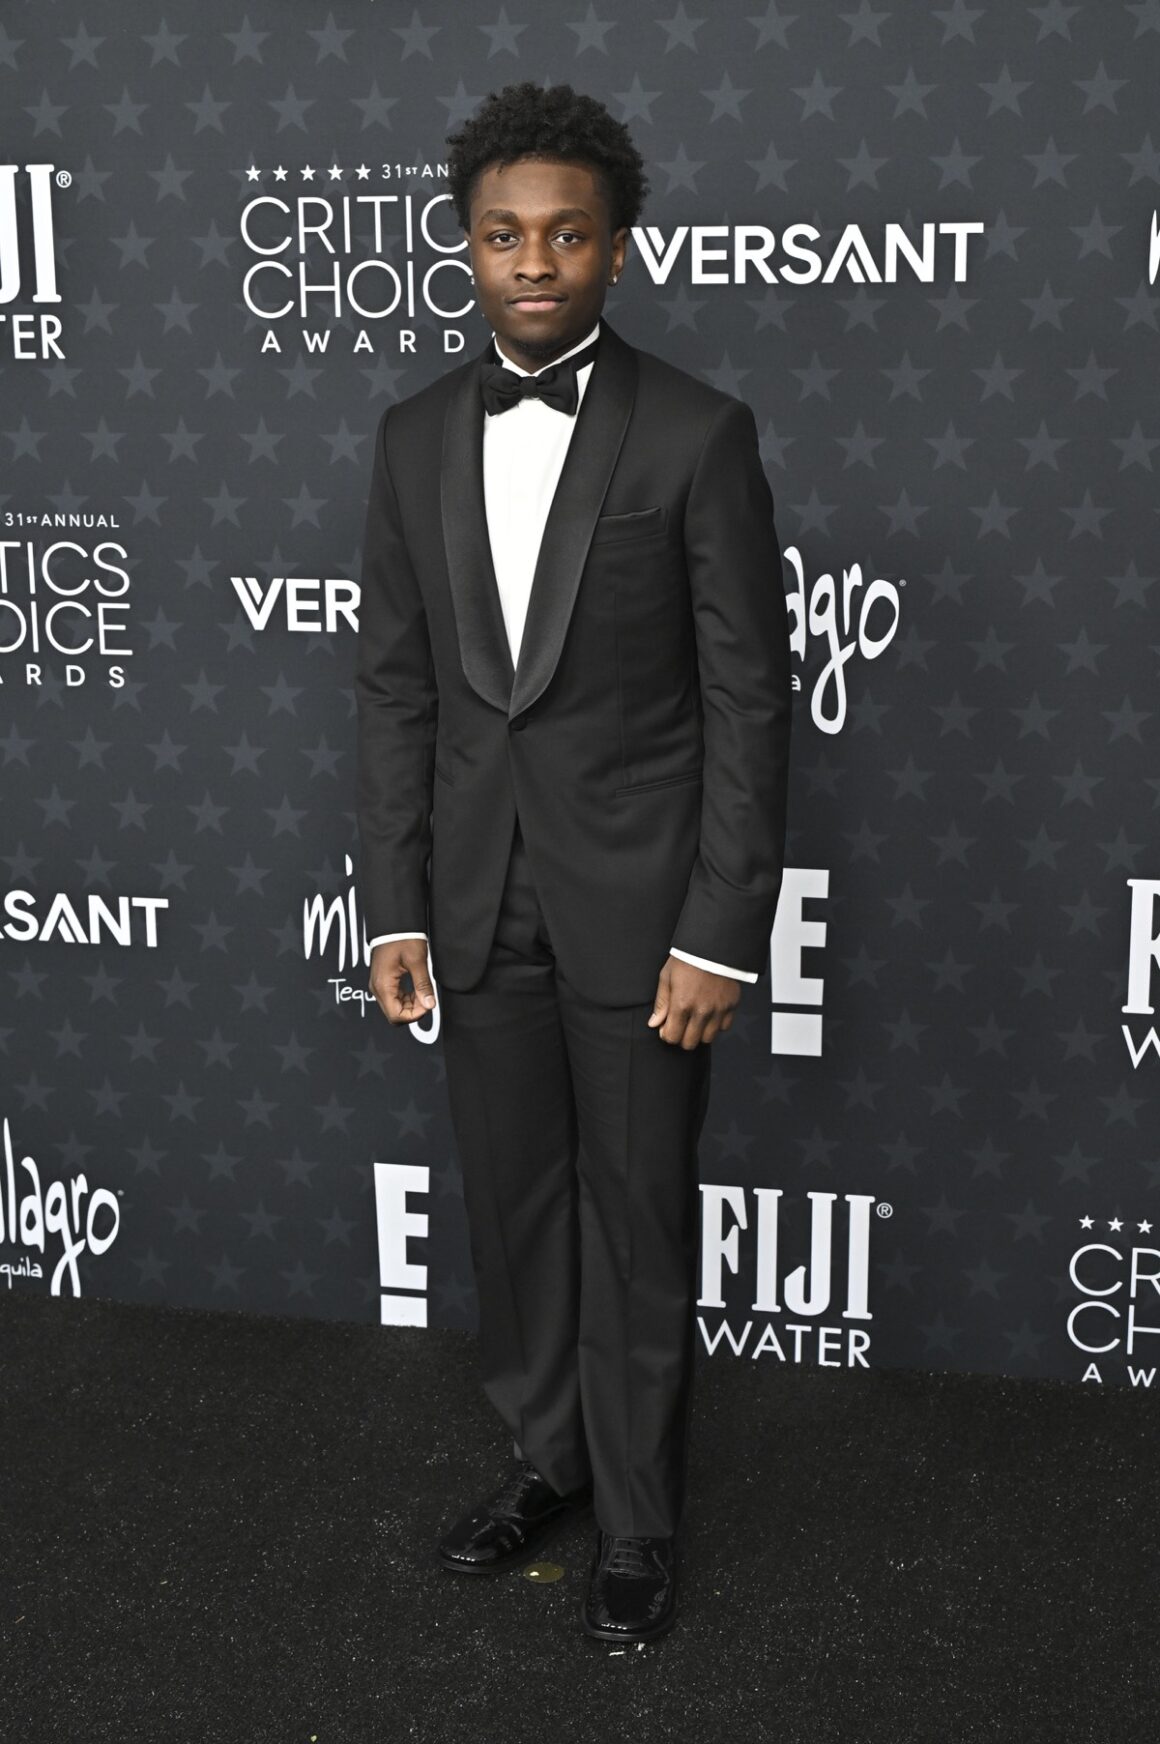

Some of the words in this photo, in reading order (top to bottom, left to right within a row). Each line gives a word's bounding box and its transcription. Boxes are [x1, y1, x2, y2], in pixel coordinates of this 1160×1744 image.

[630, 222, 985, 285] VERSANT
[0, 314, 66, 360] ER
[260, 329, 465, 353] AWARD
[40, 513, 120, 528] ANNUAL
[0, 663, 125, 689] RDS
[0, 889, 169, 948] SANT
[0, 1117, 120, 1298] lagro
[697, 1316, 871, 1368] WATER
